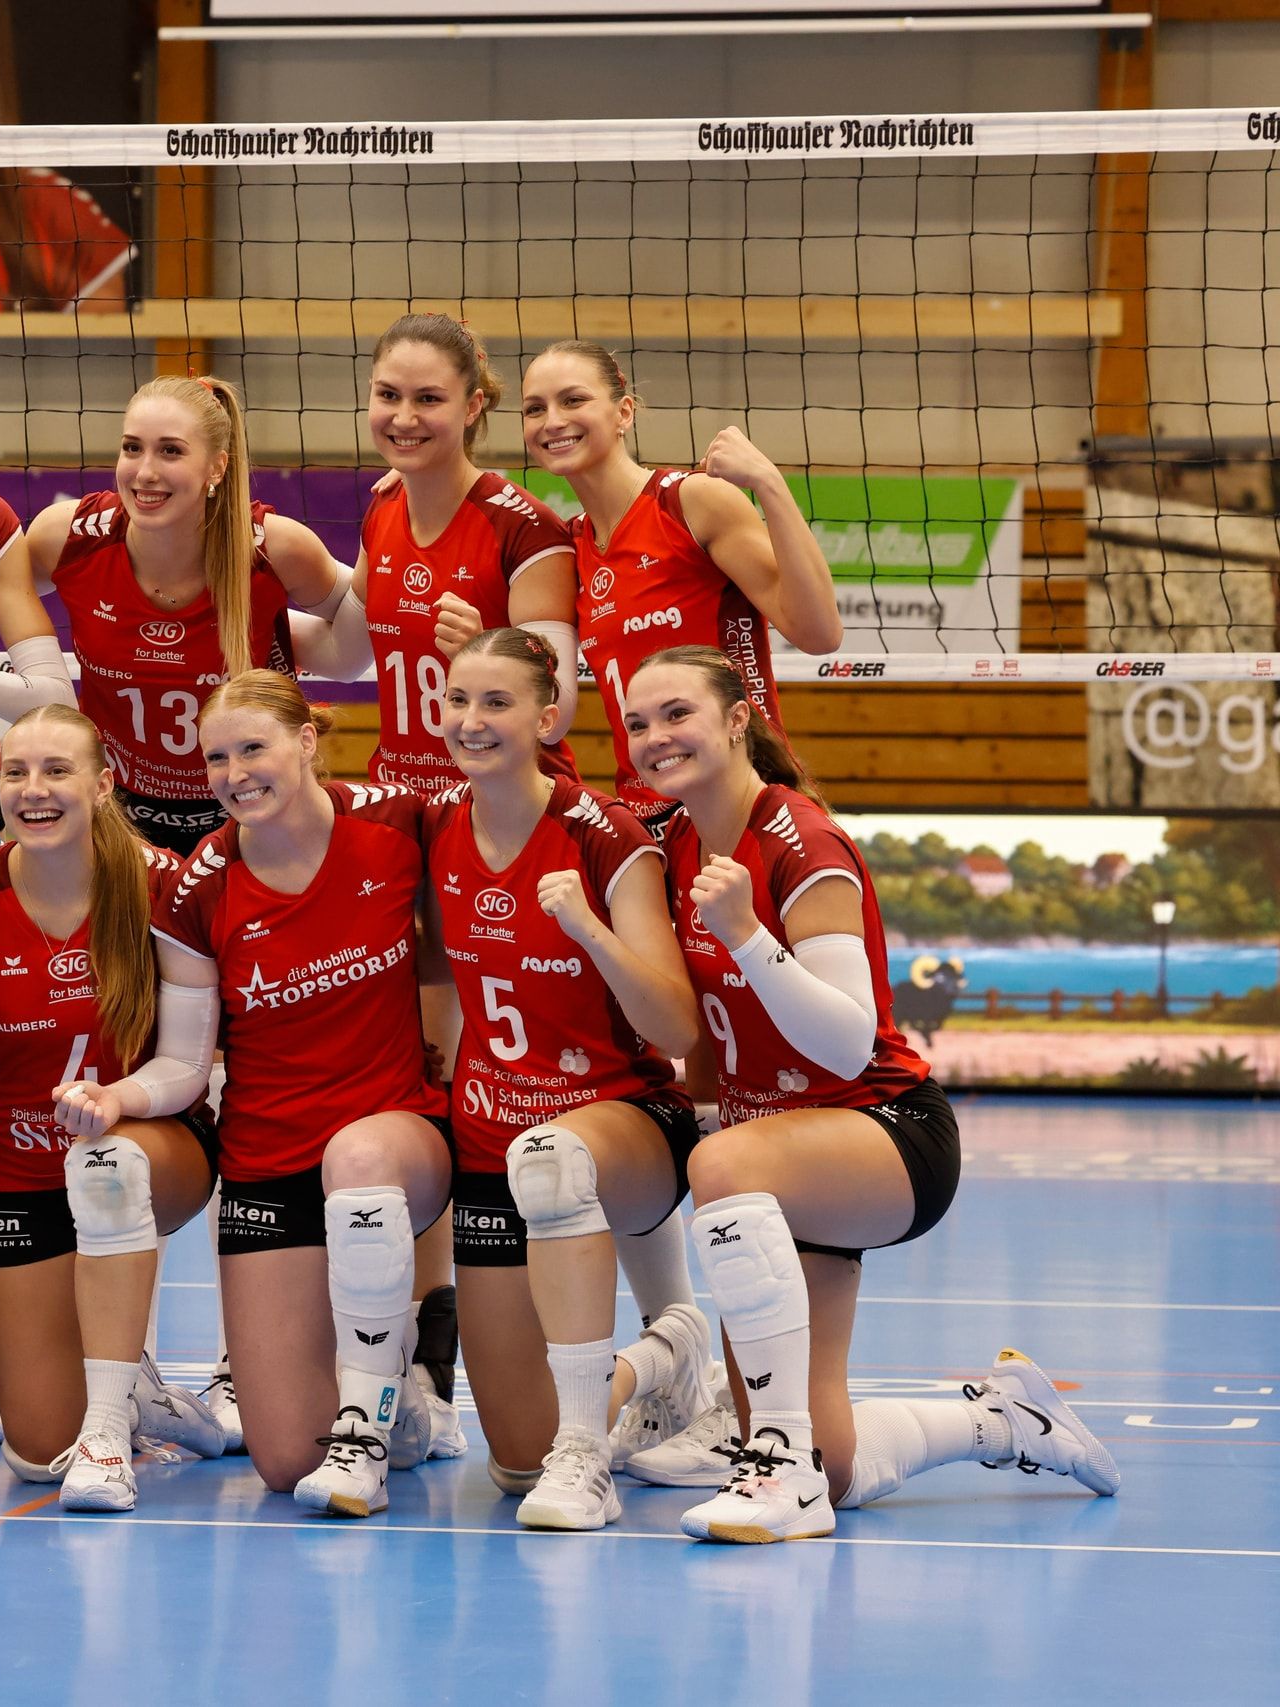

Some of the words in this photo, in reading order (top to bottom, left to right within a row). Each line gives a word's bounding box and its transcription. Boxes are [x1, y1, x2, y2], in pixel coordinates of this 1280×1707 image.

[166, 128, 298, 160] Schaffhauser
[303, 126, 434, 158] Nachrichten
[698, 121, 834, 154] Schaffhauser
[840, 118, 974, 150] Nachrichten
[406, 569, 428, 588] SIG
[594, 572, 608, 593] SIG
[399, 598, 410, 608] for
[410, 599, 431, 612] better
[598, 601, 616, 615] better
[93, 608, 117, 622] erima
[623, 606, 682, 635] sasag
[146, 622, 178, 639] SIG
[368, 622, 401, 636] MBERG
[135, 647, 150, 658] for
[153, 649, 185, 662] better
[818, 660, 886, 677] GASSER
[1096, 660, 1166, 677] GASSER
[385, 651, 447, 738] 18
[116, 687, 199, 756] 13
[400, 752, 457, 768] schaffhaus
[134, 769, 211, 792] Schaffhau
[480, 893, 510, 914] SIG
[242, 928, 270, 941] erima
[469, 923, 484, 936] for
[486, 925, 515, 940] better
[696, 941, 716, 953] better
[1, 966, 28, 976] erima
[55, 954, 90, 976] SIG
[287, 967, 309, 984] die
[308, 943, 368, 975] Mobiliar
[521, 955, 582, 977] sasag
[263, 938, 409, 1009] TOPSCORER
[722, 972, 748, 987] sas
[49, 988, 66, 999] for
[480, 975, 528, 1061] 5
[703, 993, 737, 1075] 9
[498, 1088, 598, 1107] Schaffhauser
[11, 1108, 55, 1122] spitäler
[20, 1239, 33, 1247] AG
